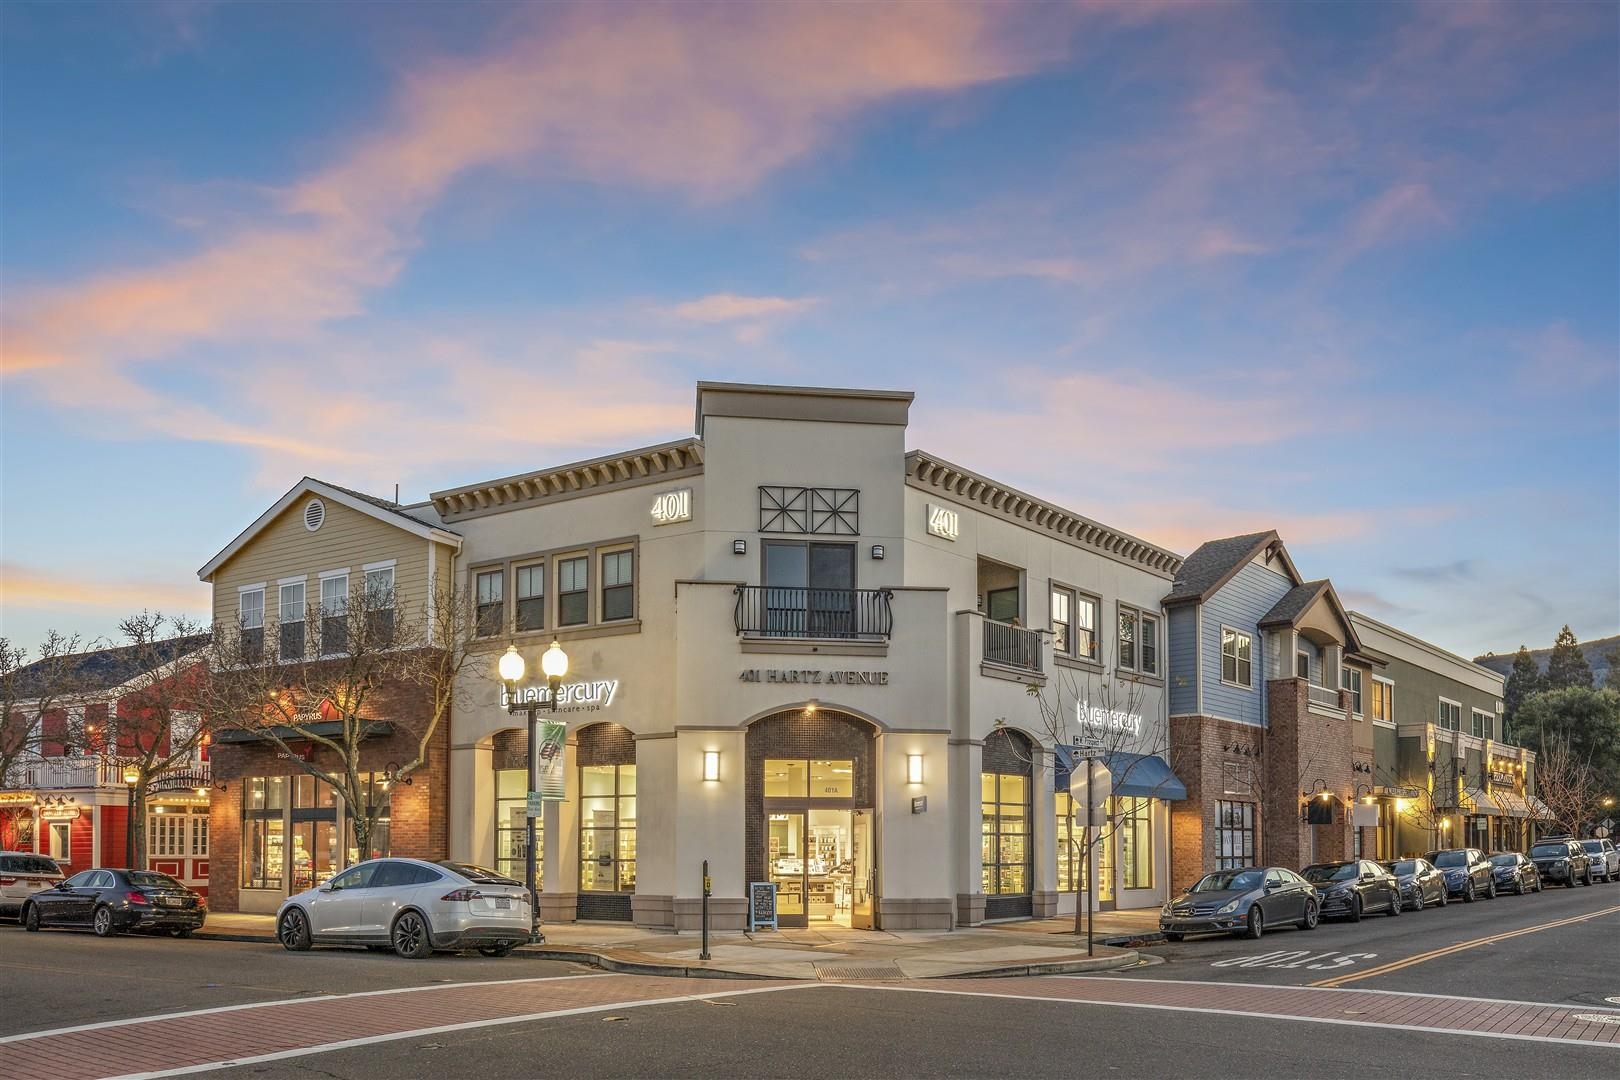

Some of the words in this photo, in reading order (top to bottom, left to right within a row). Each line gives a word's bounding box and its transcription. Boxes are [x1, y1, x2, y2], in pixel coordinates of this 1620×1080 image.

[651, 491, 689, 521] 401
[929, 508, 958, 539] 401
[738, 669, 761, 683] 401
[767, 669, 823, 685] HARTZ
[825, 671, 889, 686] AVENUE
[500, 681, 617, 708] buemercury
[547, 706, 580, 714] sincare
[587, 704, 600, 712] spa
[1080, 749, 1097, 757] Hartz
[825, 786, 839, 794] 401A
